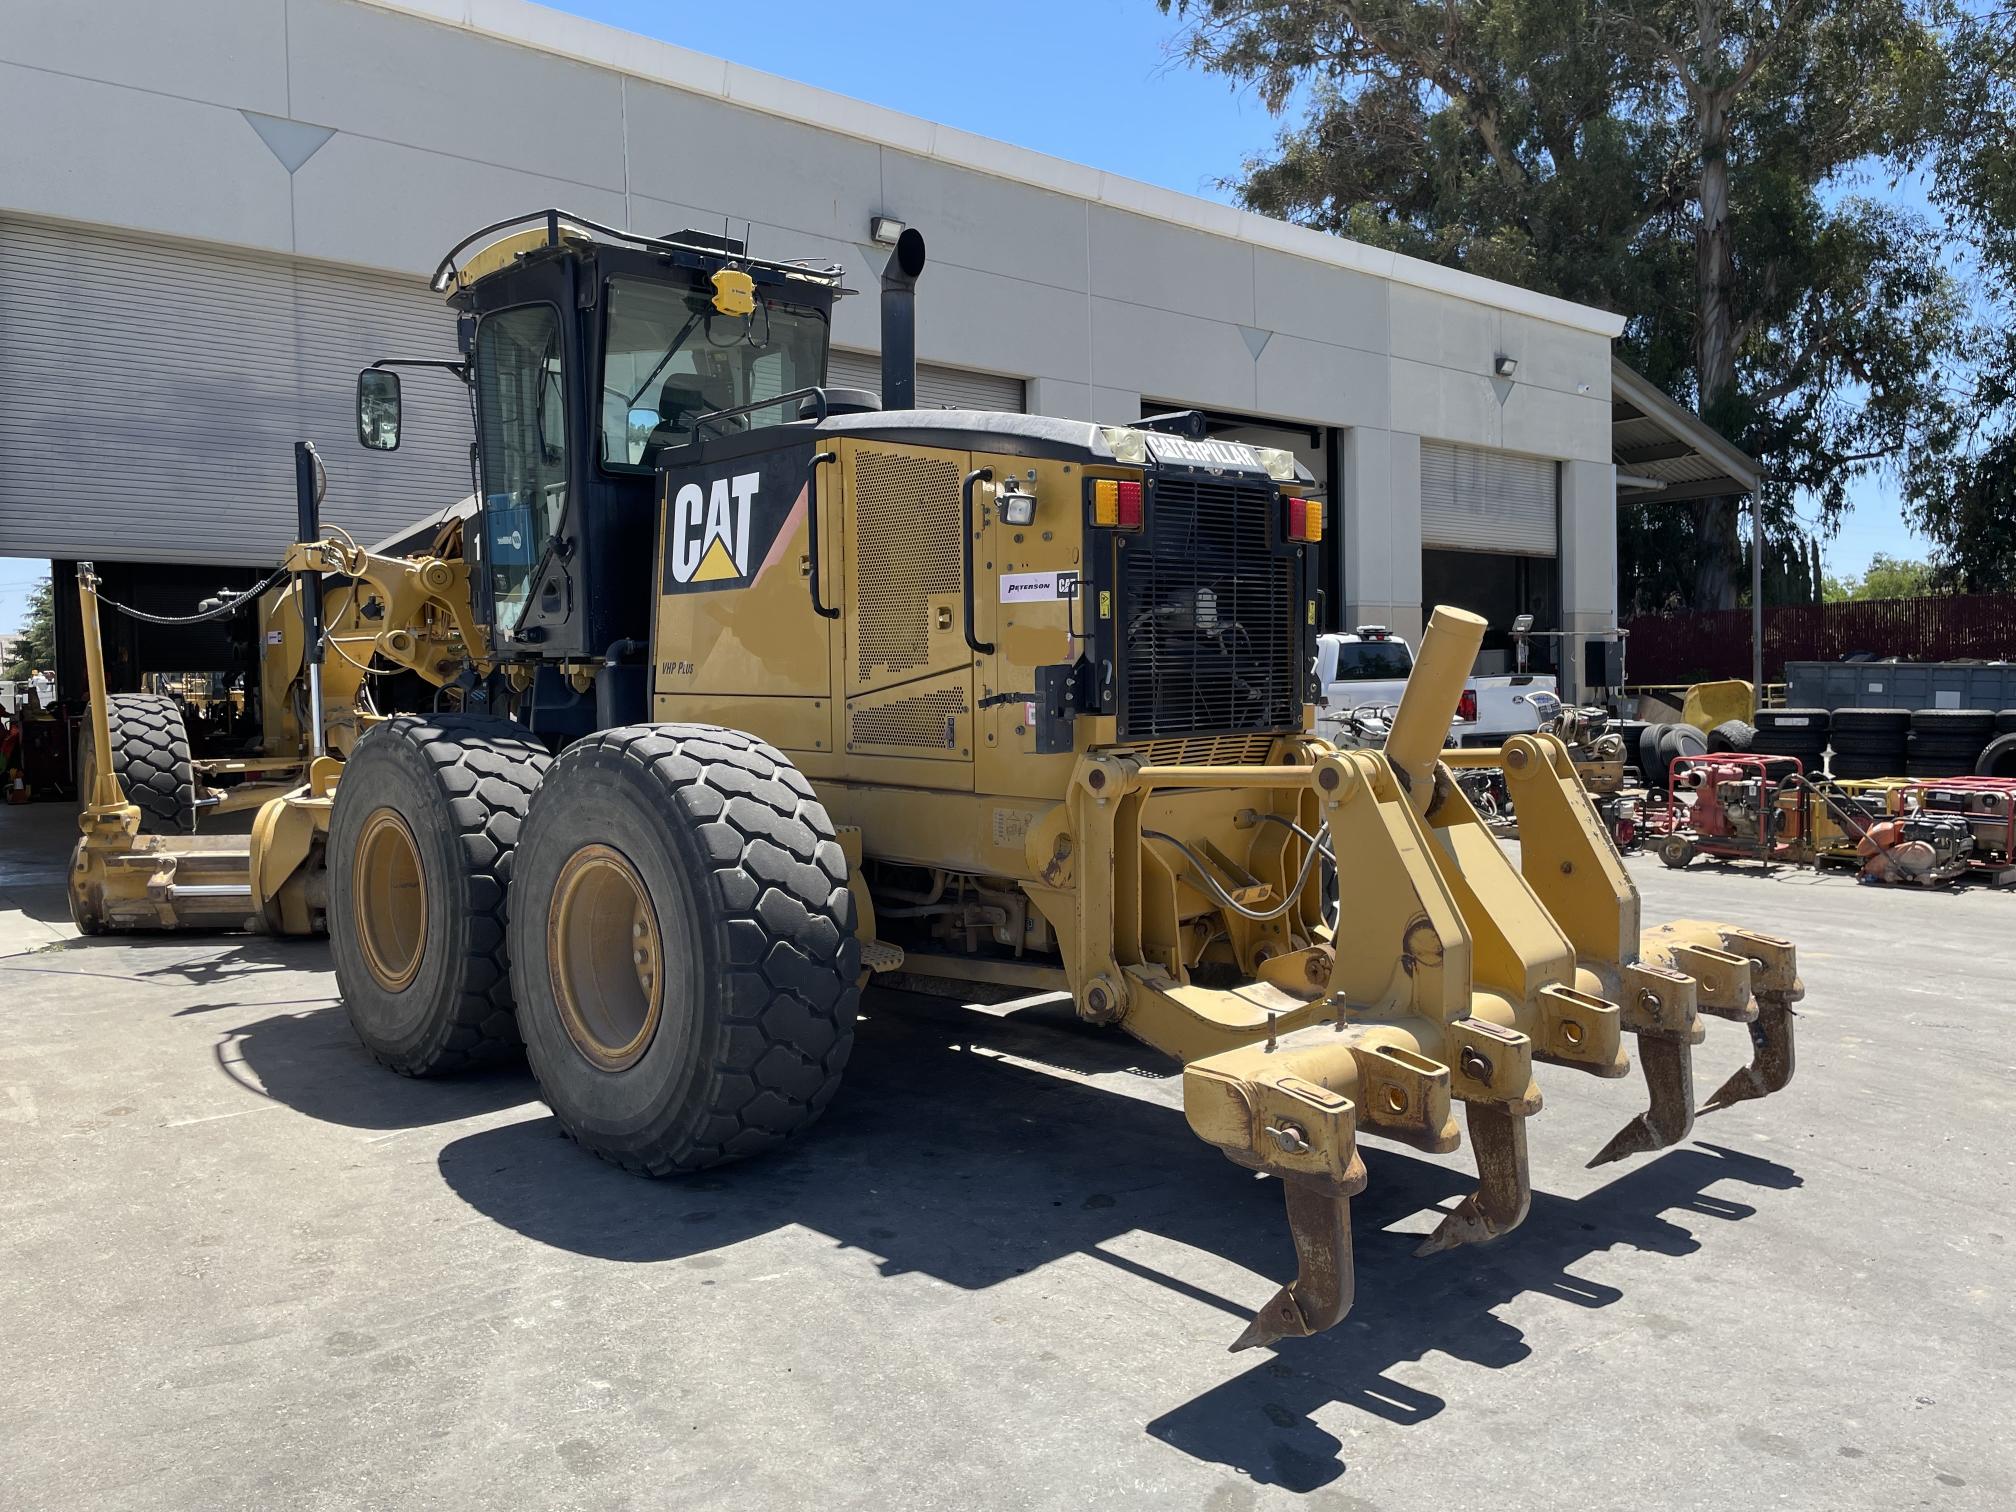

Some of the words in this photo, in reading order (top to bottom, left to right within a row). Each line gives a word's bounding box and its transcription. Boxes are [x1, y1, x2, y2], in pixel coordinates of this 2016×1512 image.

[1145, 435, 1257, 466] CATERPILLAR
[672, 471, 760, 583] CAT
[1008, 583, 1050, 594] PETERSON
[1058, 578, 1076, 593] CAT
[662, 661, 676, 675] VHP
